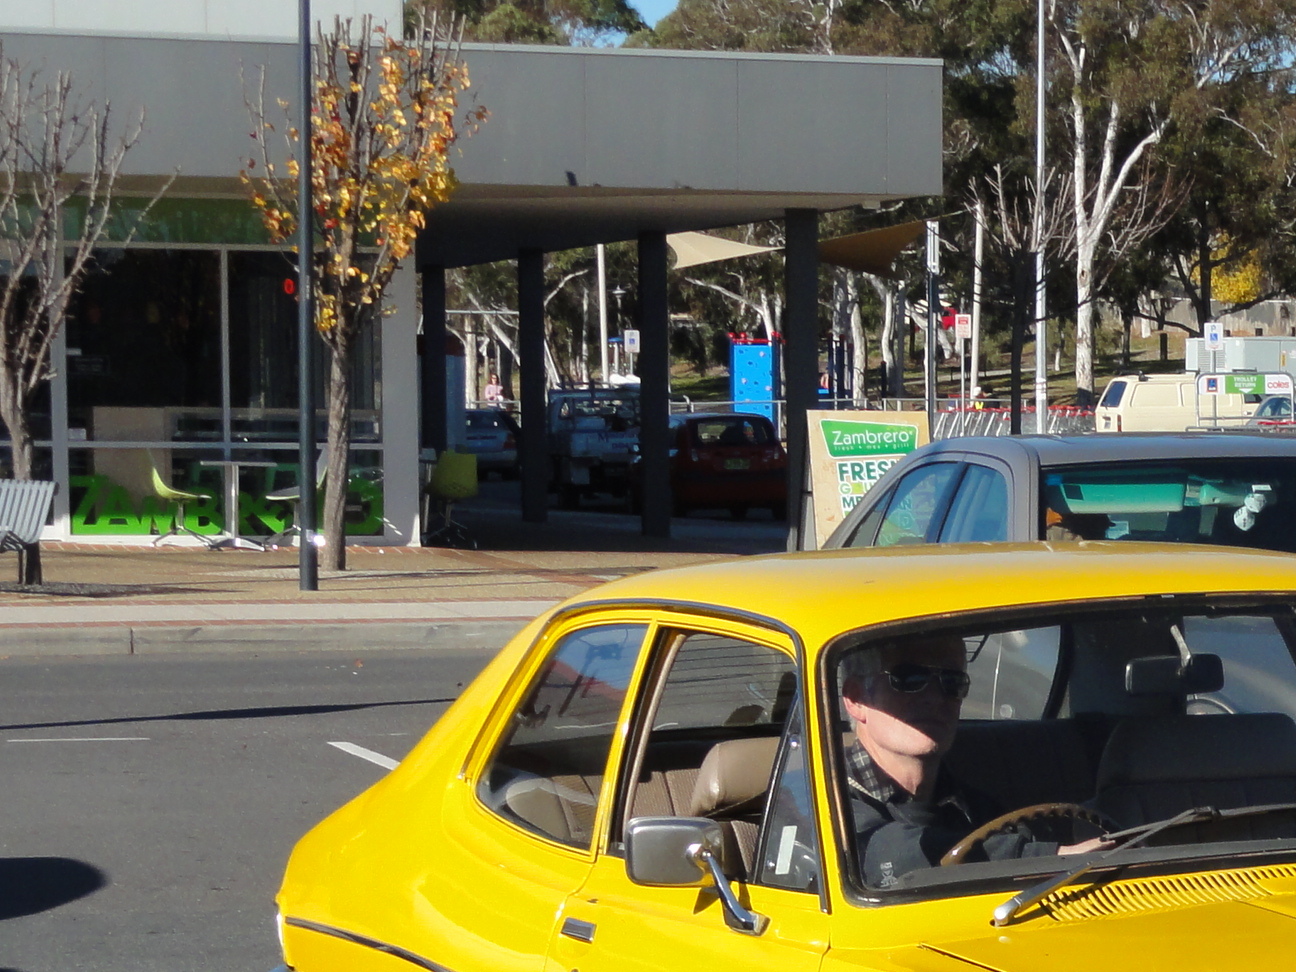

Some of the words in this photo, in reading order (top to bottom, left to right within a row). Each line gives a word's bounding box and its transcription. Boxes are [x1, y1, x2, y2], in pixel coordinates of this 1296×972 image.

[1267, 381, 1290, 389] coles
[831, 430, 910, 446] Zambrero
[838, 461, 900, 482] FRES
